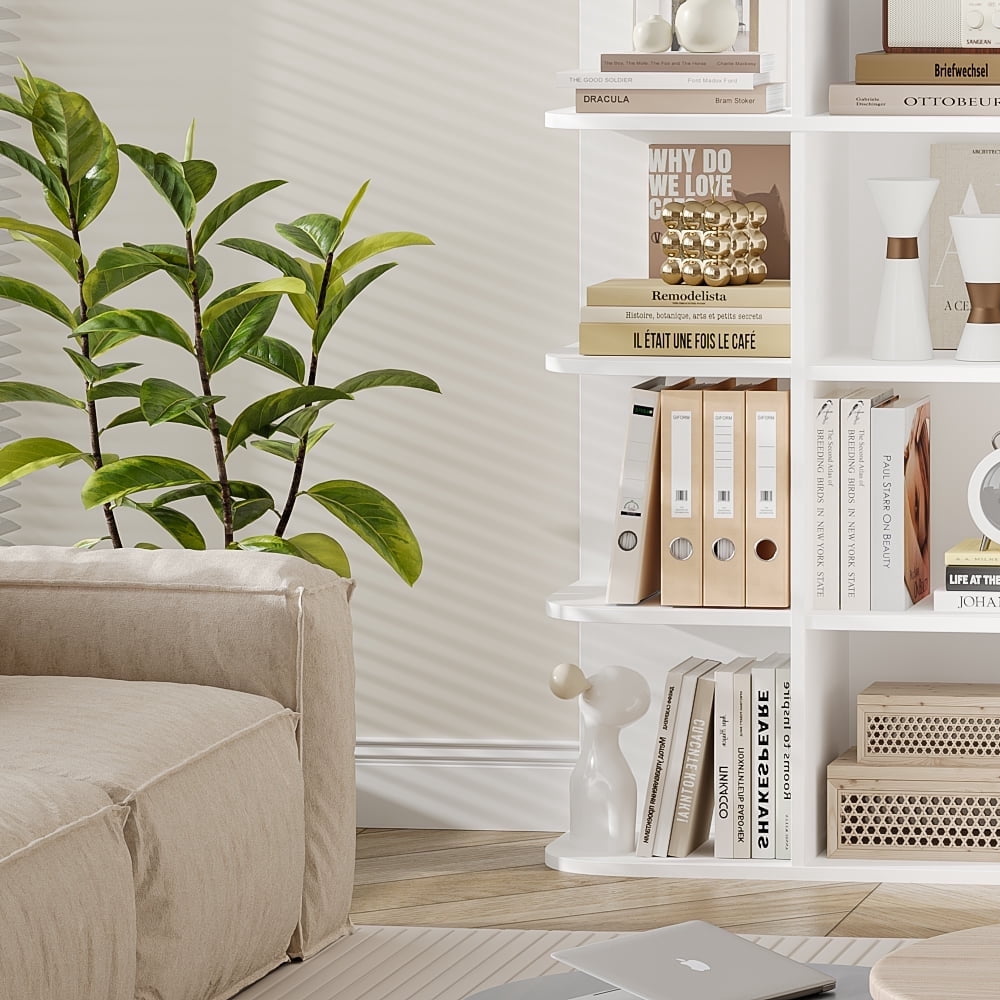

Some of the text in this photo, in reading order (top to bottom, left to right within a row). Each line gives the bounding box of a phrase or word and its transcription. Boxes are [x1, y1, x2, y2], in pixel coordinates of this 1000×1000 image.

[935, 63, 988, 78] Briefwechsel
[649, 149, 732, 172] WHY DO
[649, 175, 732, 196] WE LOVE
[652, 290, 726, 301] Remodelista
[944, 301, 951, 311] A
[625, 312, 653, 320] Histoire,
[656, 312, 690, 320] botanique,
[717, 312, 736, 320] petits
[633, 329, 756, 349] IL ÉTAIT UNE FOIS LE CAFÉ
[882, 455, 892, 479] PAUL
[882, 482, 892, 511] STARR
[816, 429, 824, 598] BREEDING BIRDS IN NEW YORK STATE
[847, 429, 855, 598] BREEDING BIRDS IN NEW YORK STATE
[882, 534, 892, 569] BEAUTY
[950, 574, 968, 584] LIFE
[970, 575, 982, 585] AT
[983, 575, 1000, 585] THE
